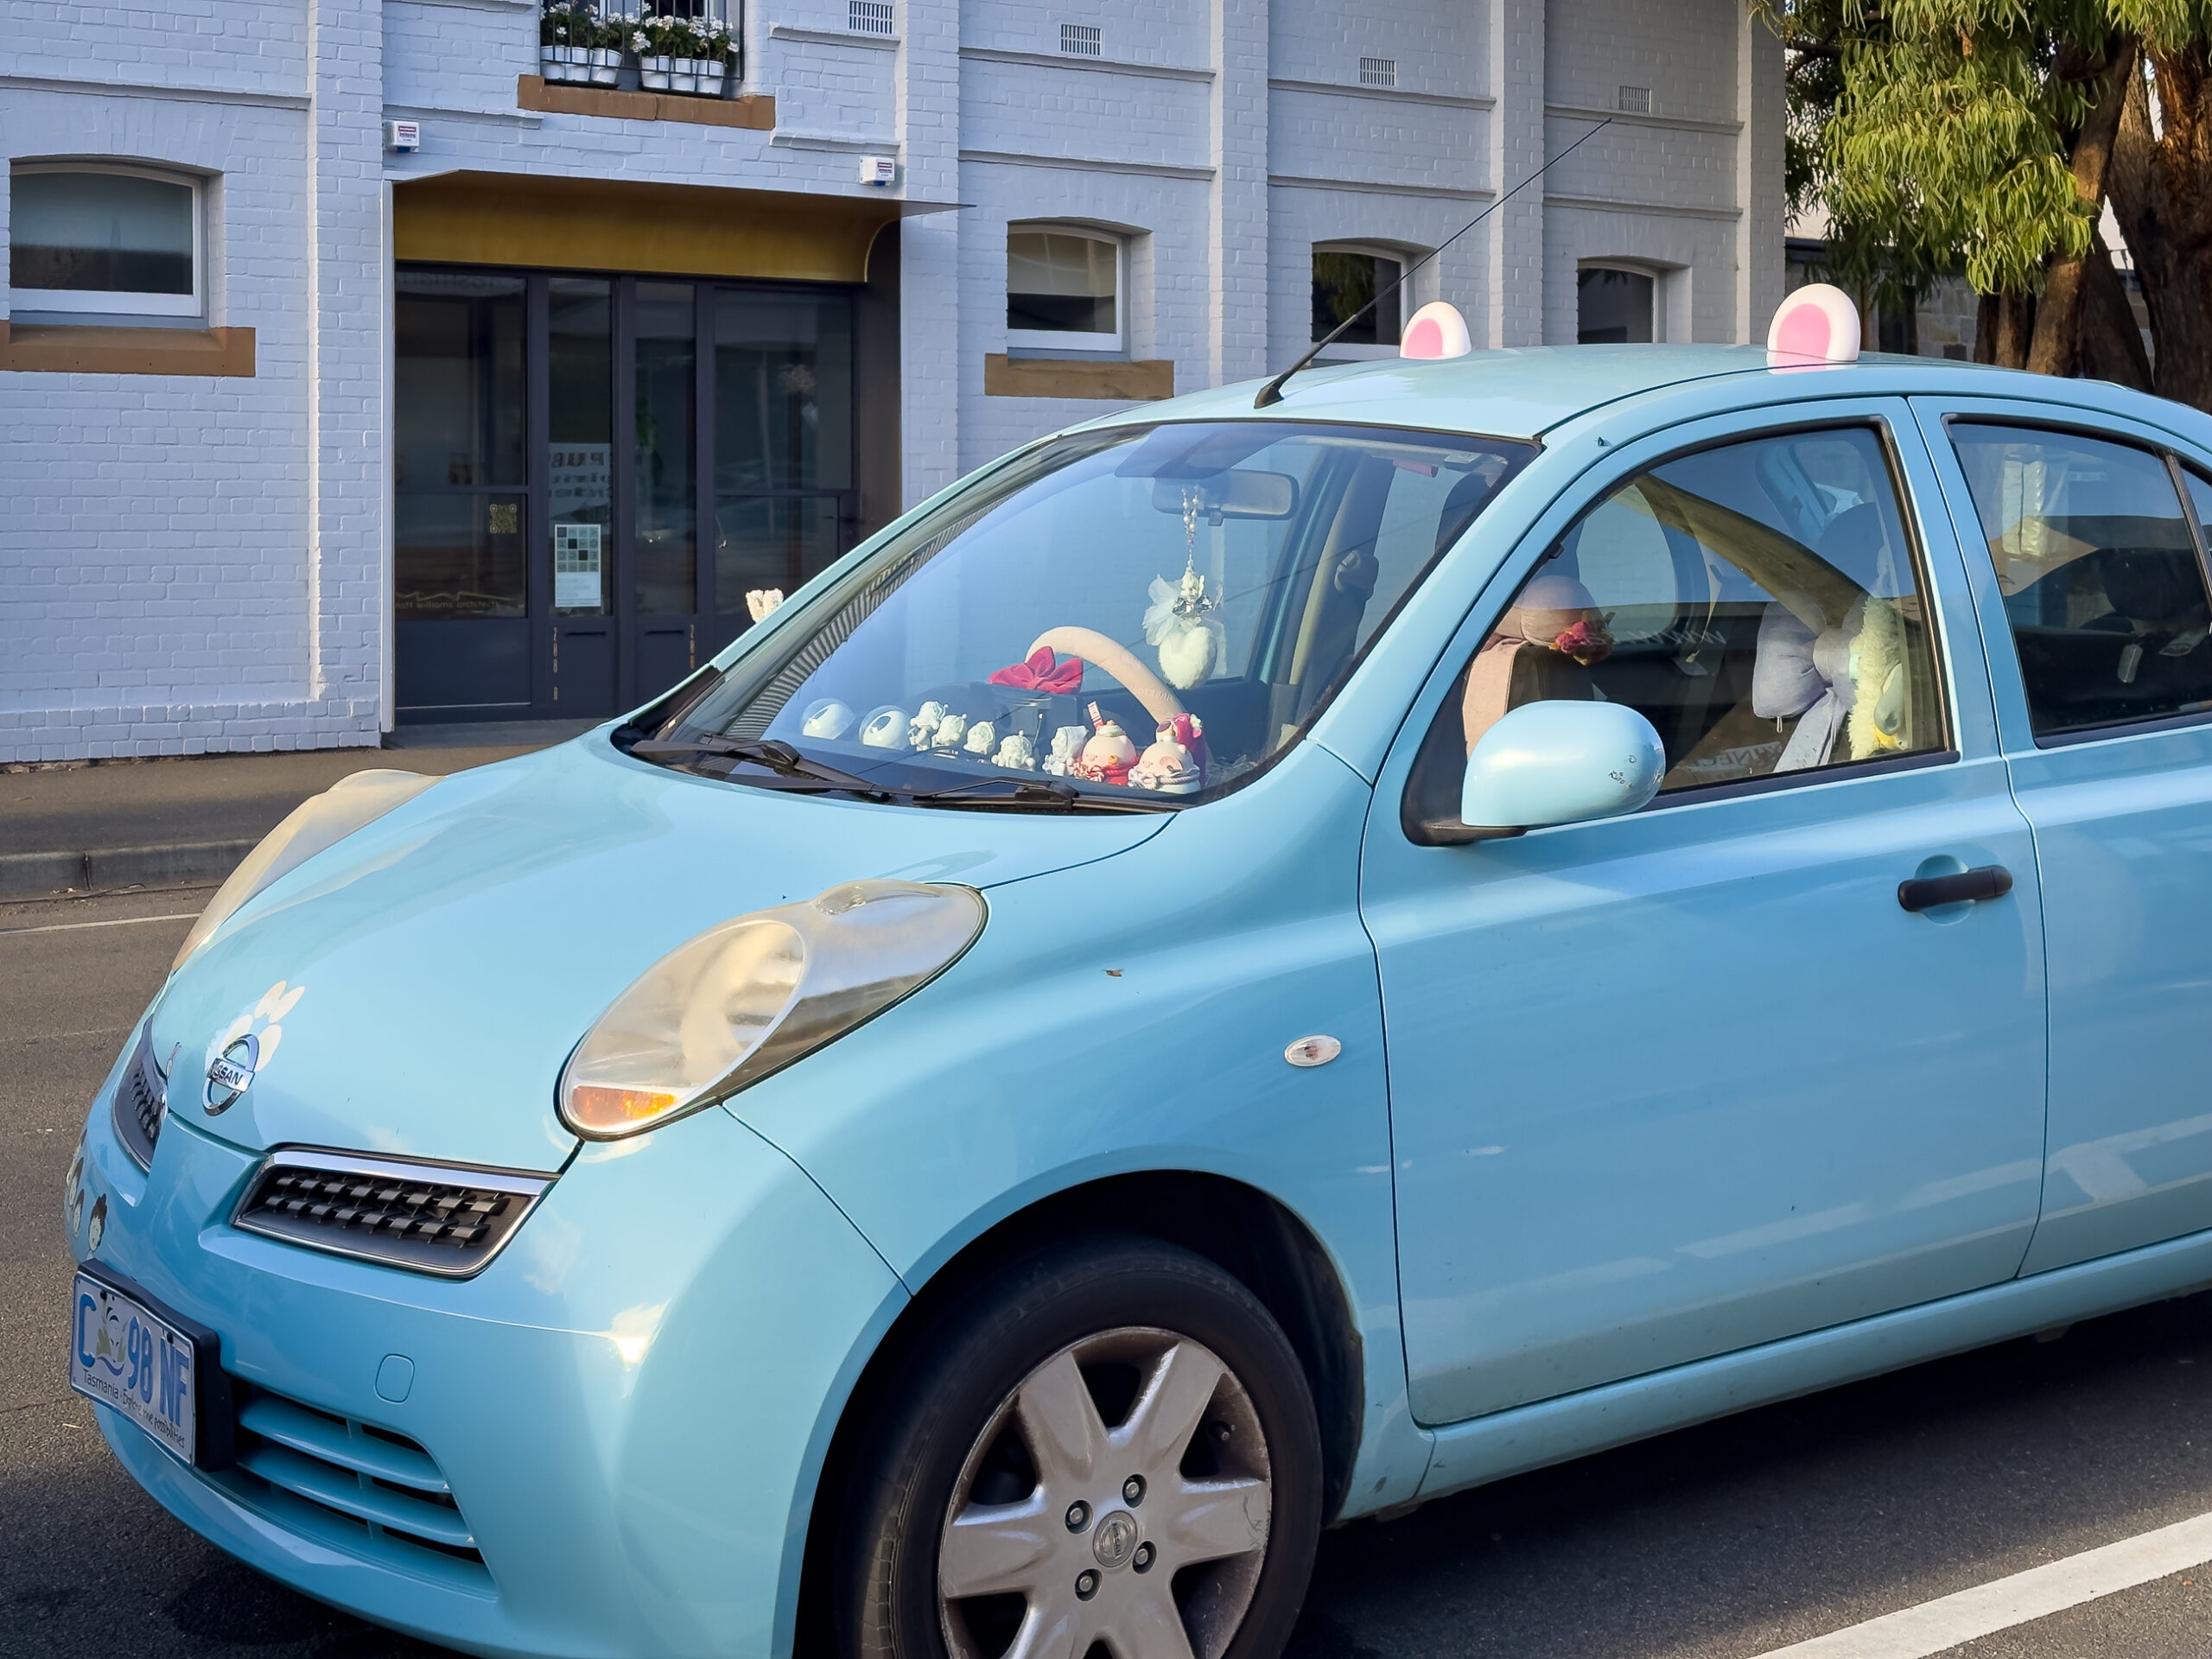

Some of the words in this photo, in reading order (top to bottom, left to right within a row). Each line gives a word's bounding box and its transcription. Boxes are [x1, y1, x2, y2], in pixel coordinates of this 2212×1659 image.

[78, 1293, 96, 1368] C
[128, 1315, 153, 1404] 98
[159, 1337, 189, 1427] NF
[83, 1368, 119, 1400] Tasmania
